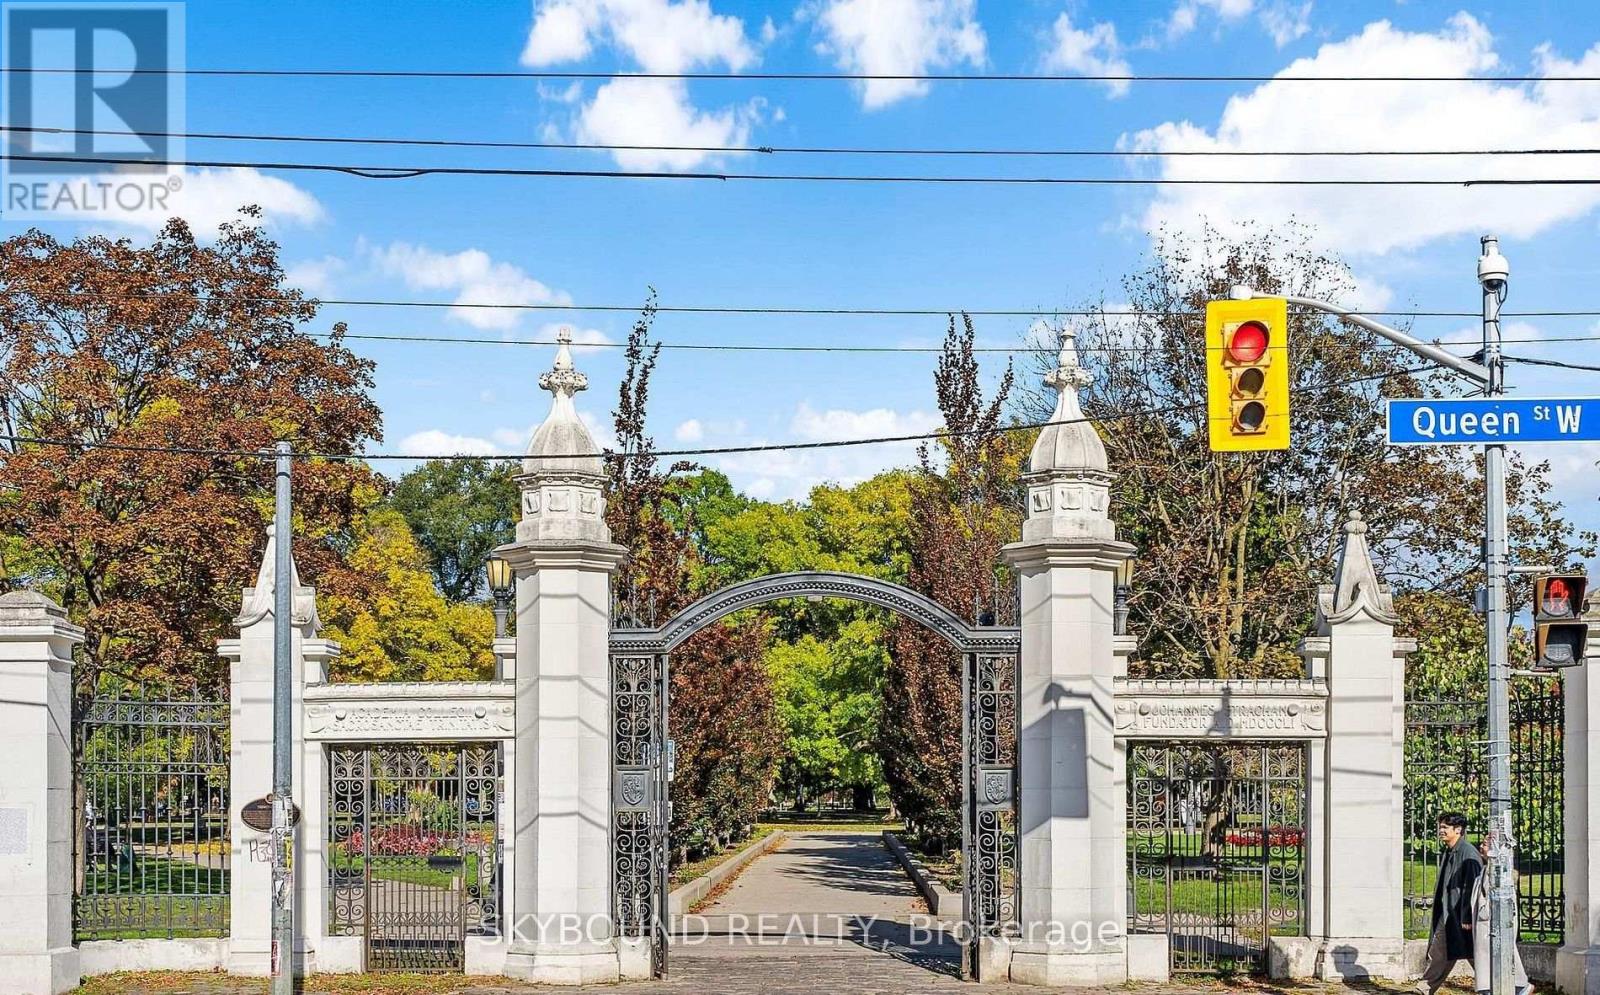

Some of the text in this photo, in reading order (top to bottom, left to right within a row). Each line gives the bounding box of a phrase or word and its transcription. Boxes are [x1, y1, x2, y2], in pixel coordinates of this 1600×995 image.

[1412, 404, 1582, 438] Queen St W
